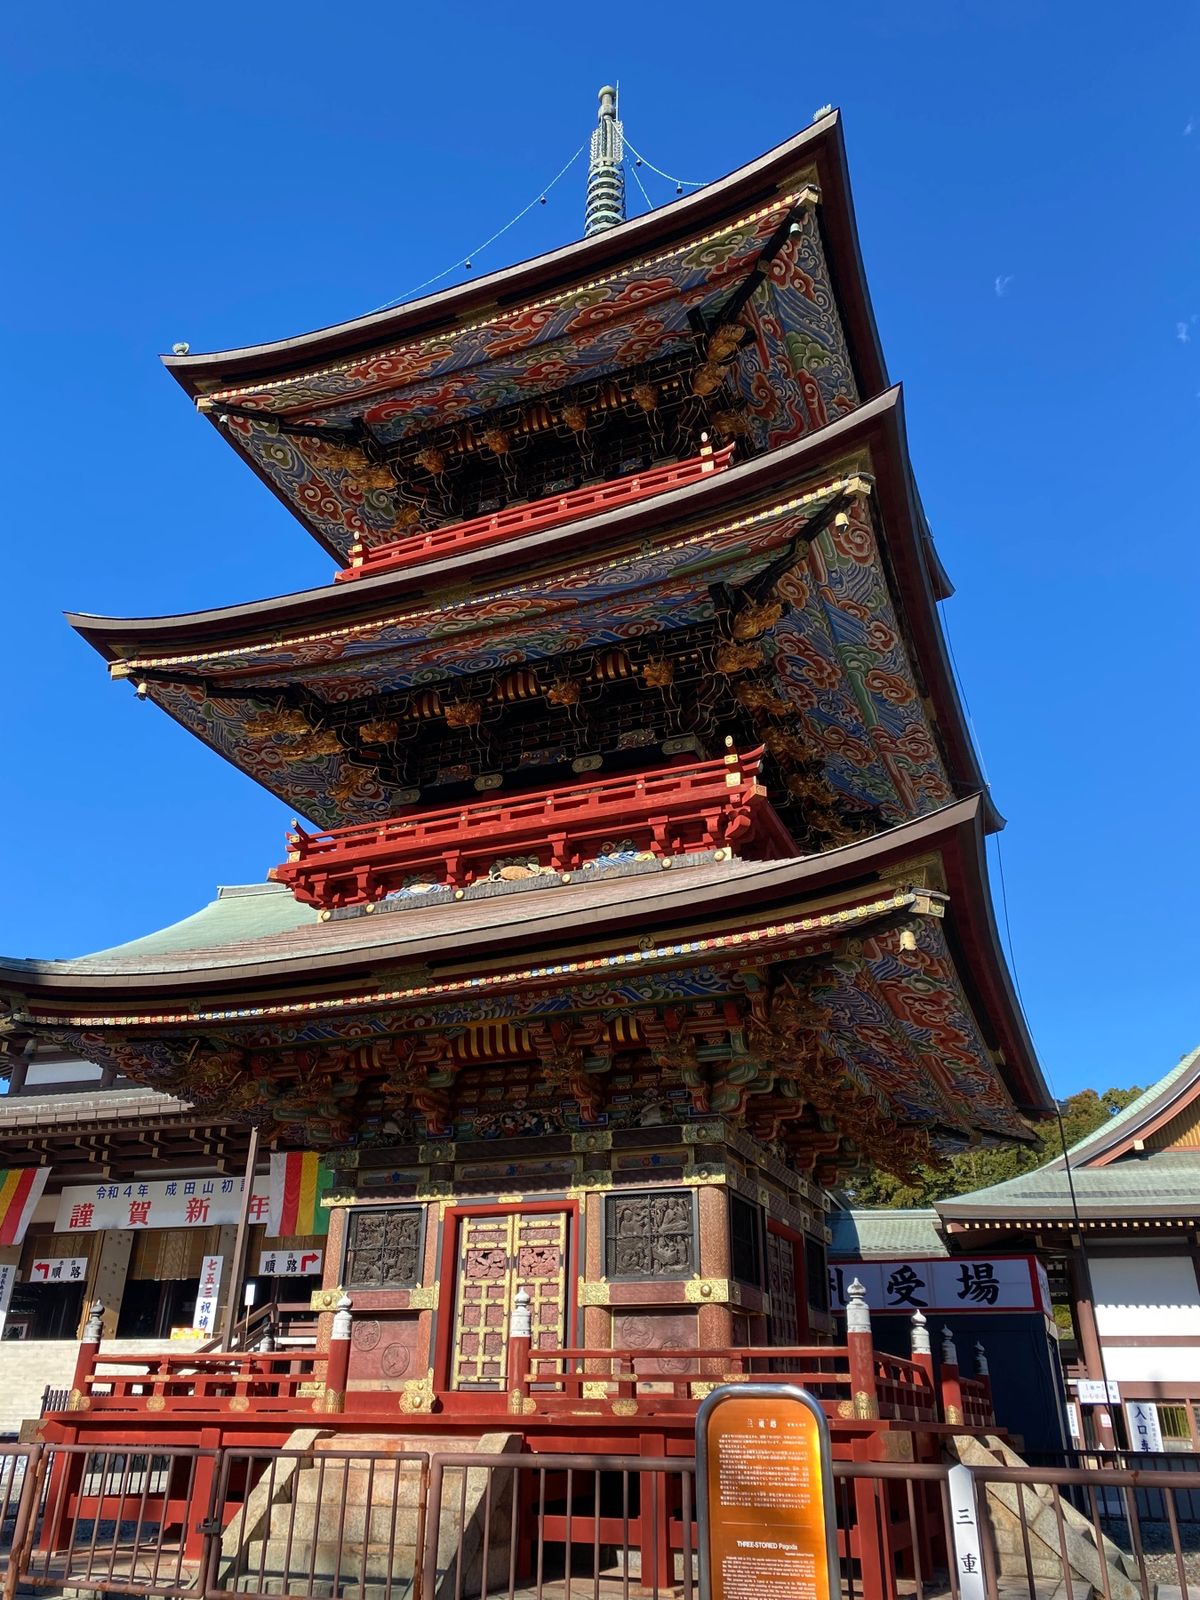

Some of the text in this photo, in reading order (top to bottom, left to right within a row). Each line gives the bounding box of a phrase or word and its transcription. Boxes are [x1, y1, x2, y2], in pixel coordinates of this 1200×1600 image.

[69, 1195, 270, 1229] 謹賀新年
[264, 1259, 298, 1273] 順路
[956, 1508, 978, 1574] 三重
